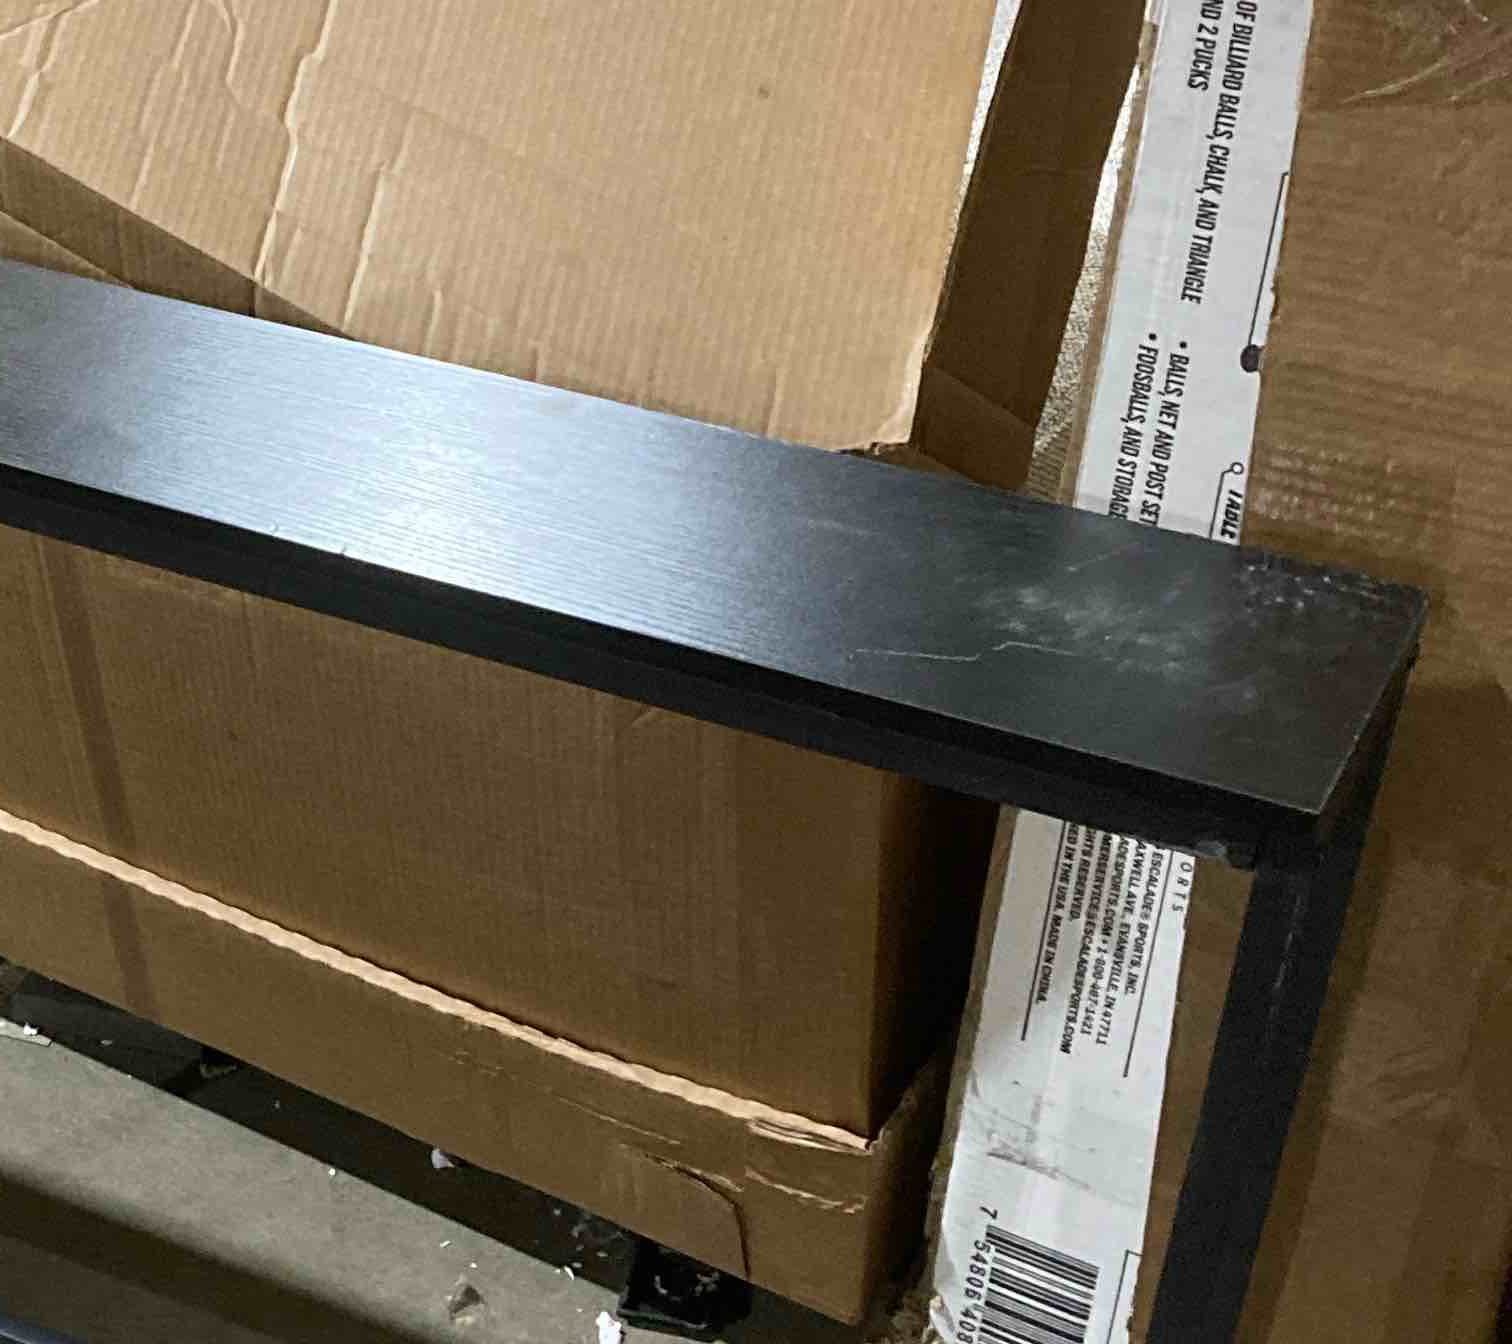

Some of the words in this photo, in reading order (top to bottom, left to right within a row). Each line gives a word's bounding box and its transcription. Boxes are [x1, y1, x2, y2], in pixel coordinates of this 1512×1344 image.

[1234, 0, 1257, 21] OF
[1197, 22, 1218, 36] 2
[1186, 37, 1216, 90] PUCKS
[1220, 21, 1254, 90] BILLIARD
[1206, 91, 1239, 143] BALLS,
[1196, 142, 1229, 196] CHALK,
[1194, 197, 1219, 230] AND
[1180, 232, 1213, 303] TRIANGLE
[1122, 344, 1161, 425] FOOSBALLS,
[1159, 352, 1193, 400] BALLS,
[1155, 399, 1181, 430] NET
[1118, 426, 1143, 457] AND
[1150, 429, 1175, 460] AND
[1142, 460, 1169, 499] POST
[1137, 499, 1161, 526] SET
[1063, 846, 1075, 859] IN
[1059, 861, 1072, 883] THE
[1046, 914, 1062, 947] MADE
[1043, 950, 1055, 964] IN
[979, 1206, 998, 1219] 7
[964, 1240, 991, 1301] 54806
